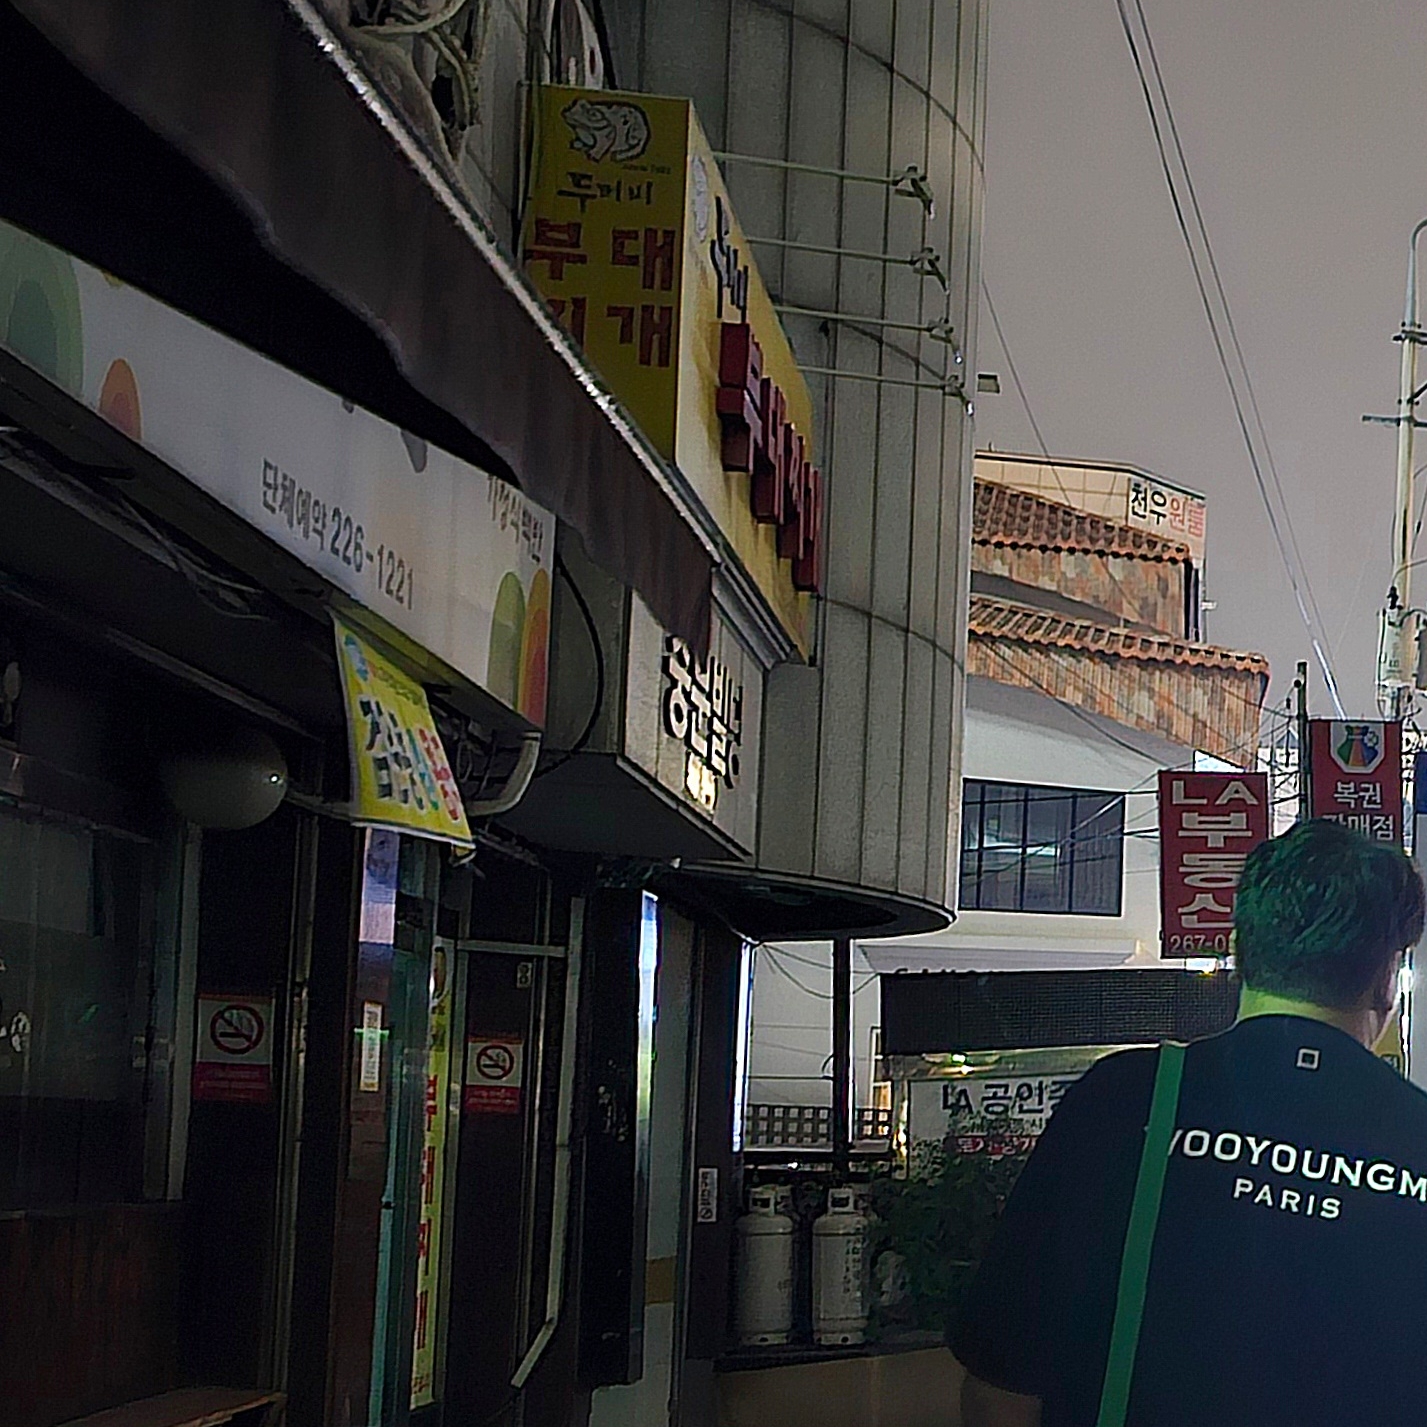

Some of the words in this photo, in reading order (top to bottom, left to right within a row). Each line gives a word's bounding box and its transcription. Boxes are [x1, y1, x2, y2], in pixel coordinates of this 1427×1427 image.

[1131, 482, 1205, 538] 천우원룸
[262, 457, 328, 550] 단체예약
[330, 506, 415, 611] 226-1221
[1171, 779, 1259, 806] LA
[1333, 780, 1382, 810] 복권
[1177, 811, 1253, 930] 부동산
[1170, 933, 1230, 954] 267-0
[941, 1084, 973, 1112] LA
[1232, 1176, 1344, 1221] PARIS
